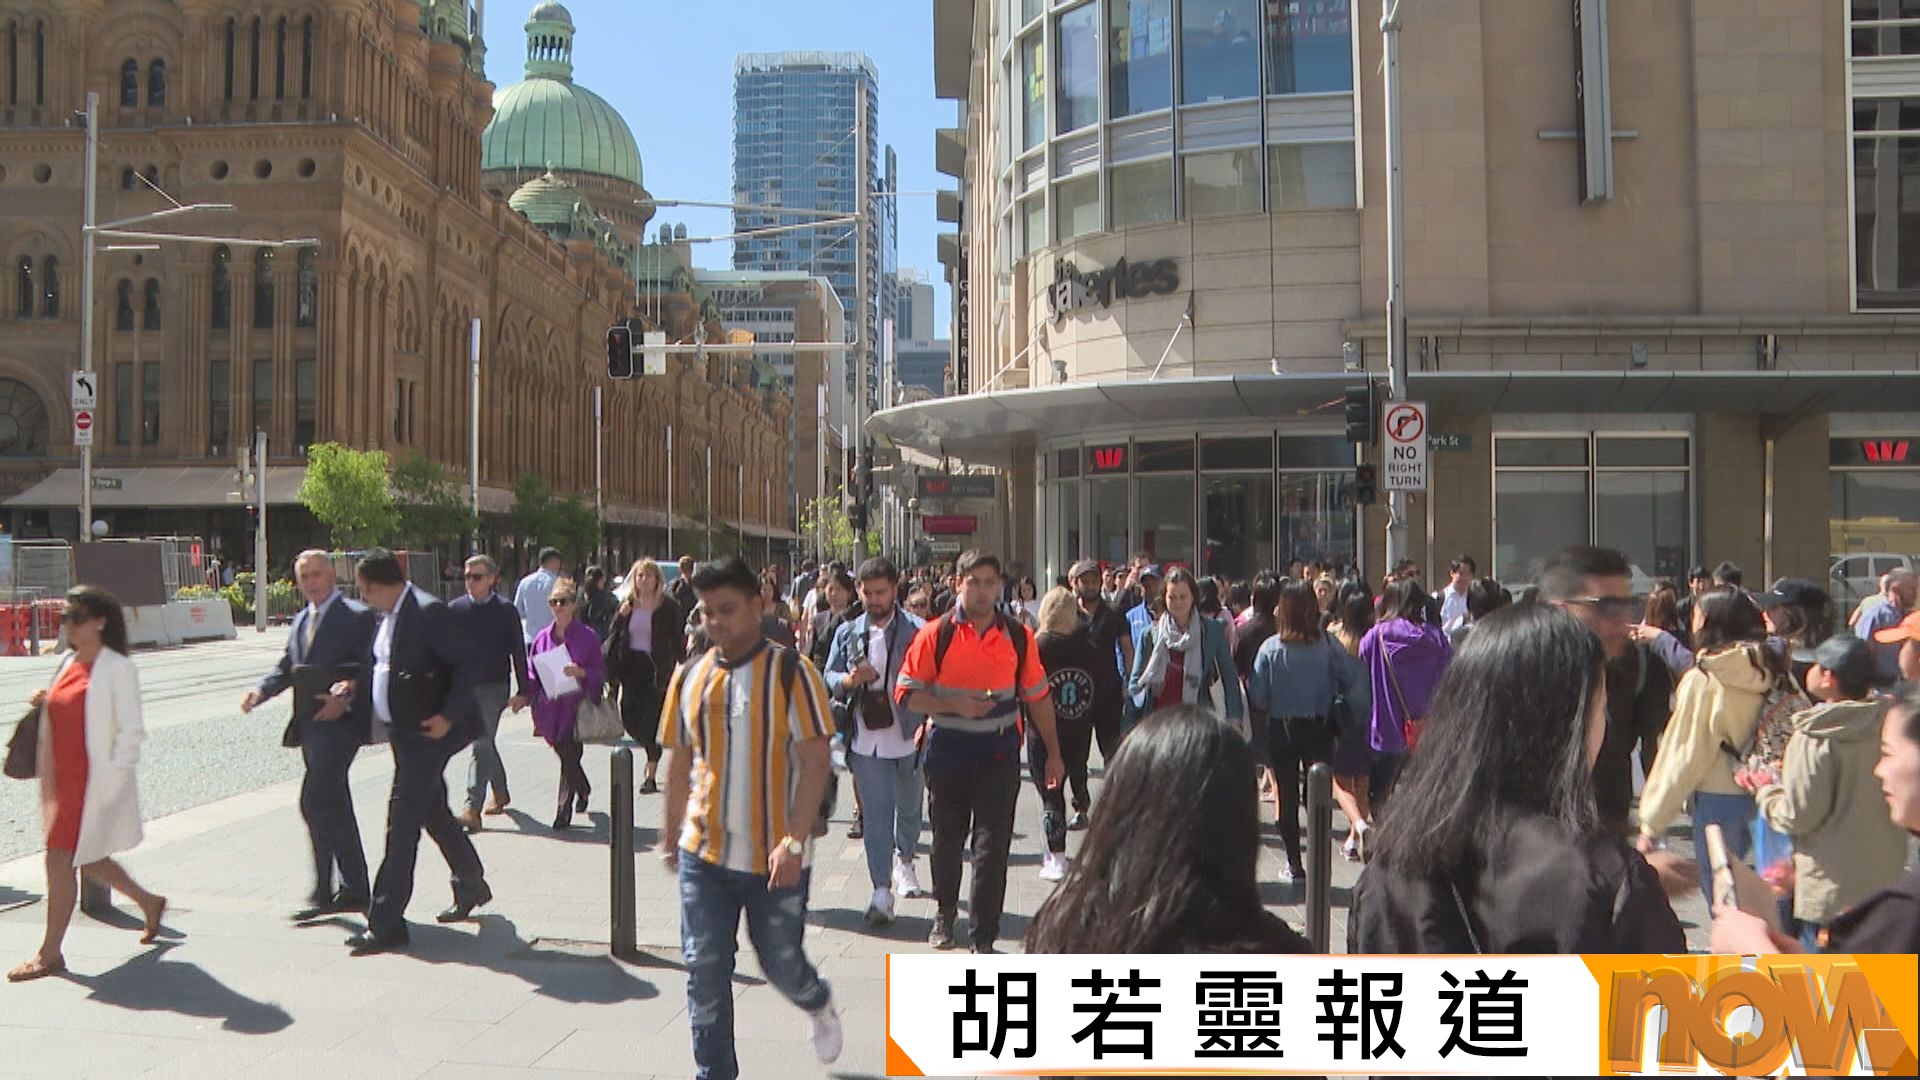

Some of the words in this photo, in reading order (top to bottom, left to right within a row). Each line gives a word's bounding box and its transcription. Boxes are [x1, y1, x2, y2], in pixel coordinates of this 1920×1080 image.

[1449, 435, 1459, 446] St
[1393, 446, 1417, 460] NO
[1388, 462, 1422, 473] RIGHT
[1389, 476, 1421, 486] TURN
